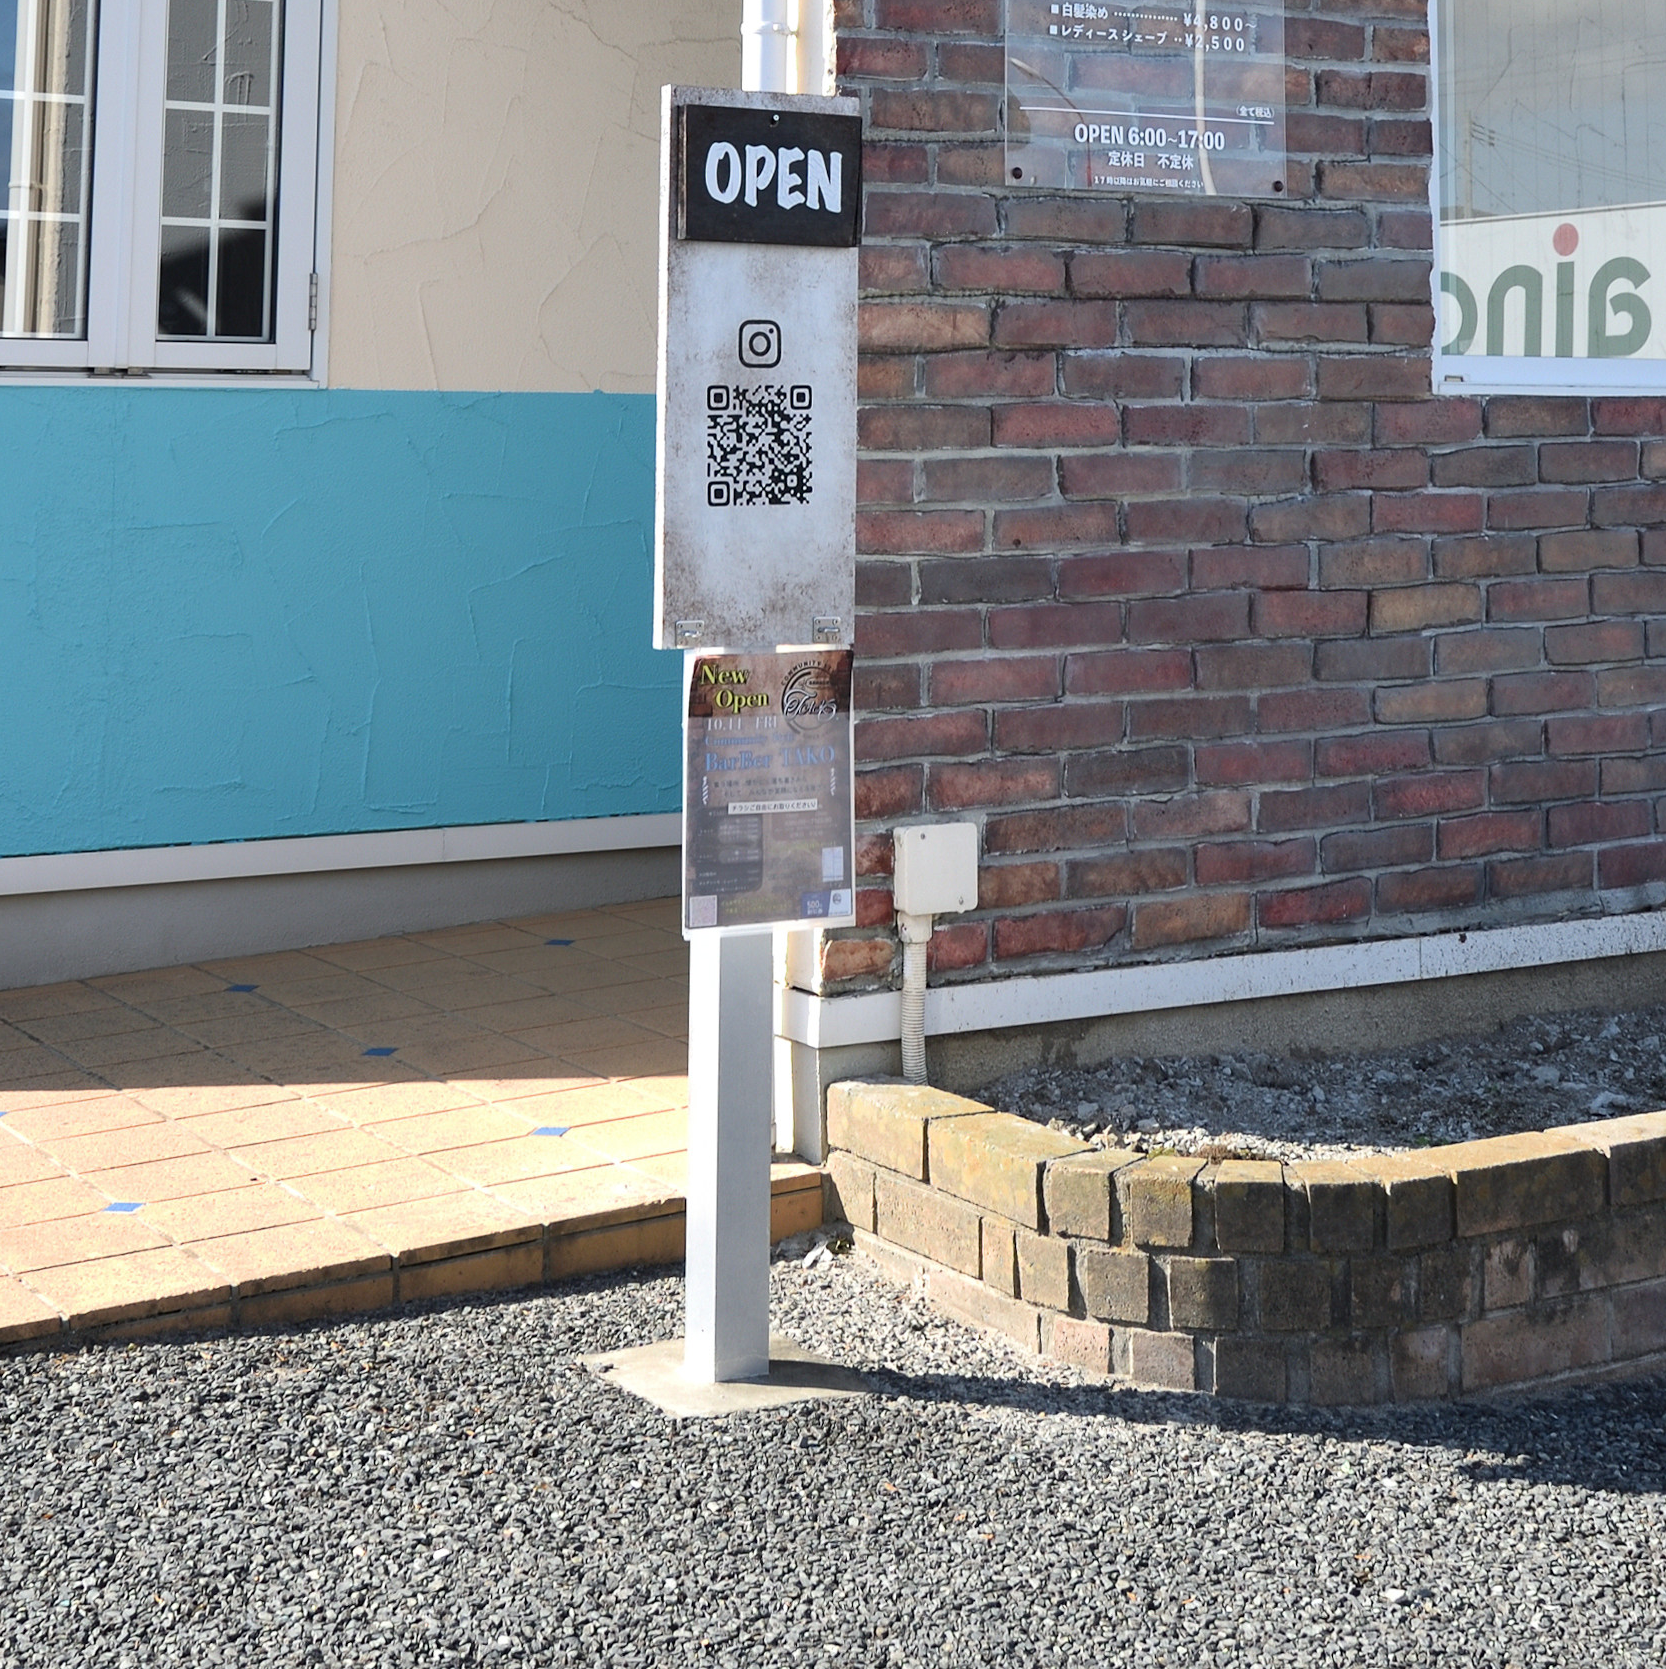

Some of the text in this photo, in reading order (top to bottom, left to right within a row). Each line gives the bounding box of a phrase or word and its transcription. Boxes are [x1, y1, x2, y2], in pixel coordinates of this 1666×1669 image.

[1074, 123, 1124, 145] OPEN
[1108, 150, 1194, 171] 定休日 不定休
[704, 139, 844, 215] OPEN
[701, 664, 750, 685] New
[715, 689, 769, 714] Open
[779, 745, 836, 766] TAKO
